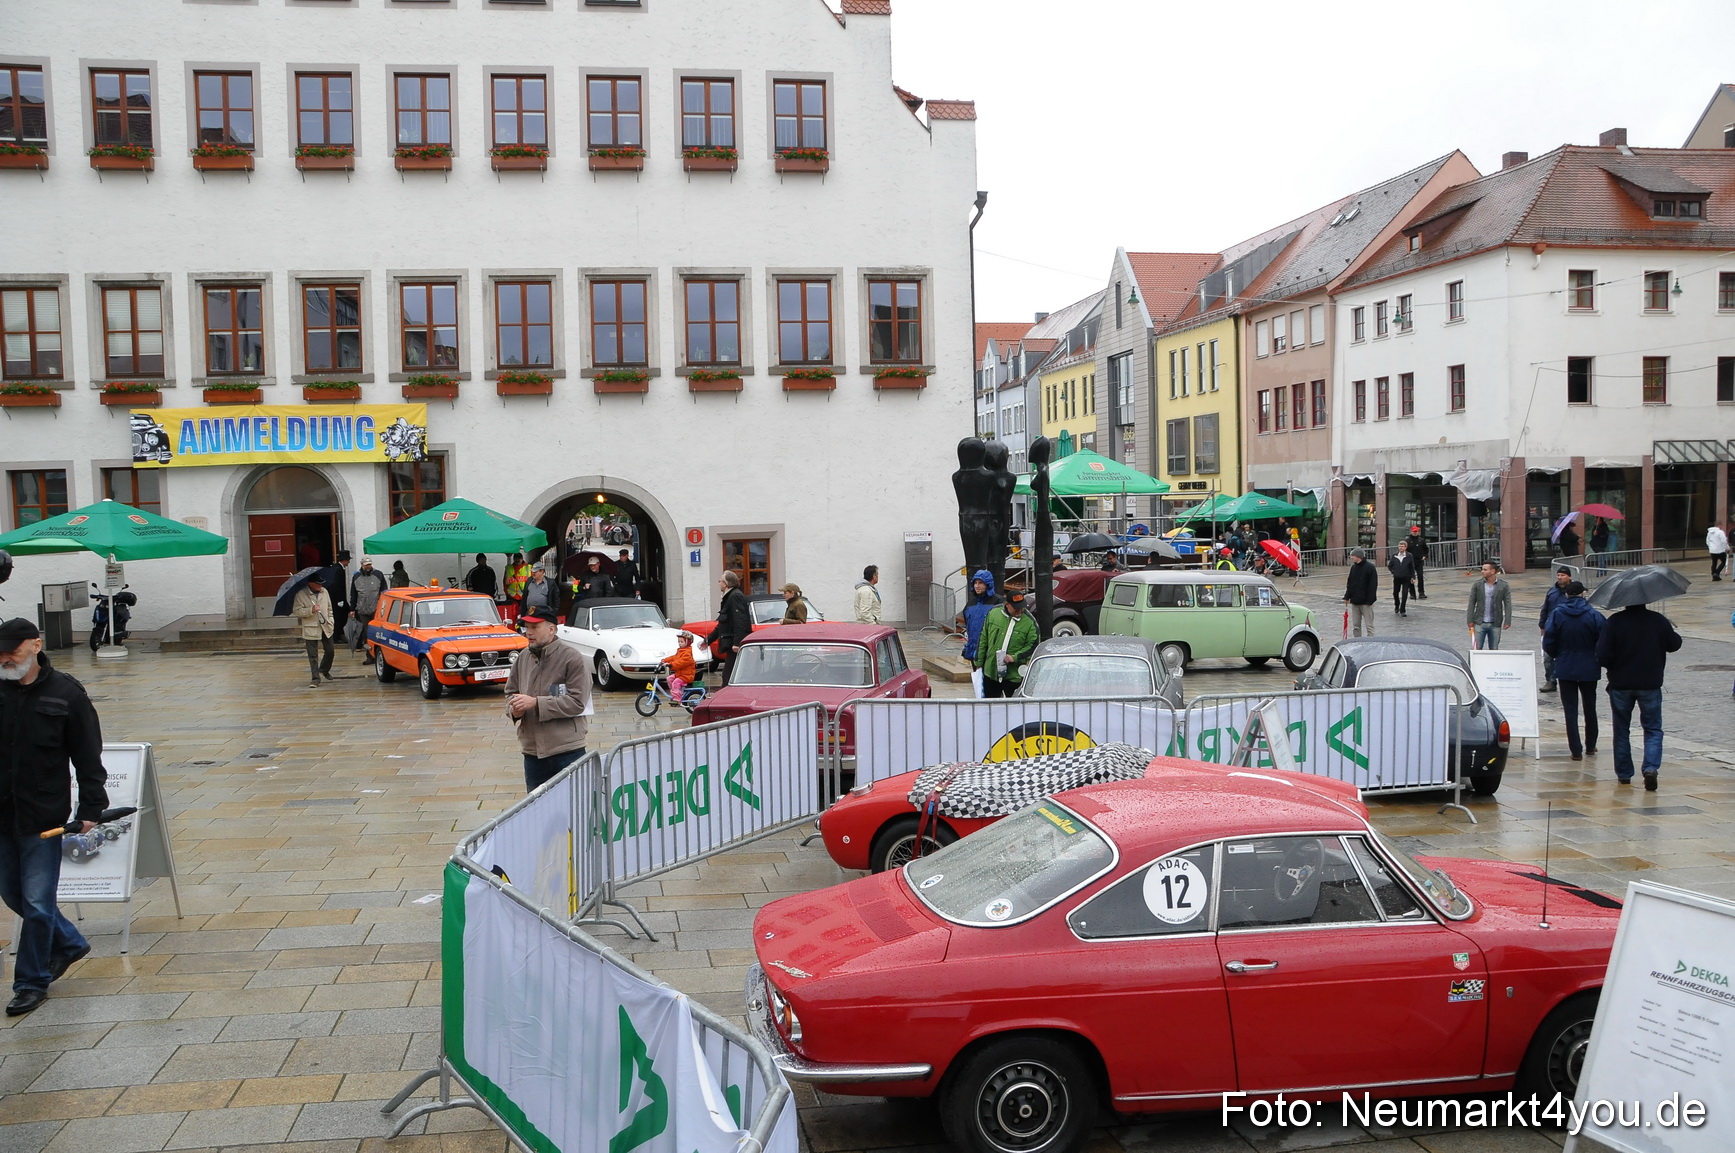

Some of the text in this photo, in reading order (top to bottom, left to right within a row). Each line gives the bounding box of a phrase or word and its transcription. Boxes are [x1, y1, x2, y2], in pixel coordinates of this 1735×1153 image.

[177, 415, 376, 455] ANMELDUNG
[1158, 859, 1189, 872] ADAC
[1161, 874, 1192, 909] 12
[1690, 966, 1729, 987] DEKRA
